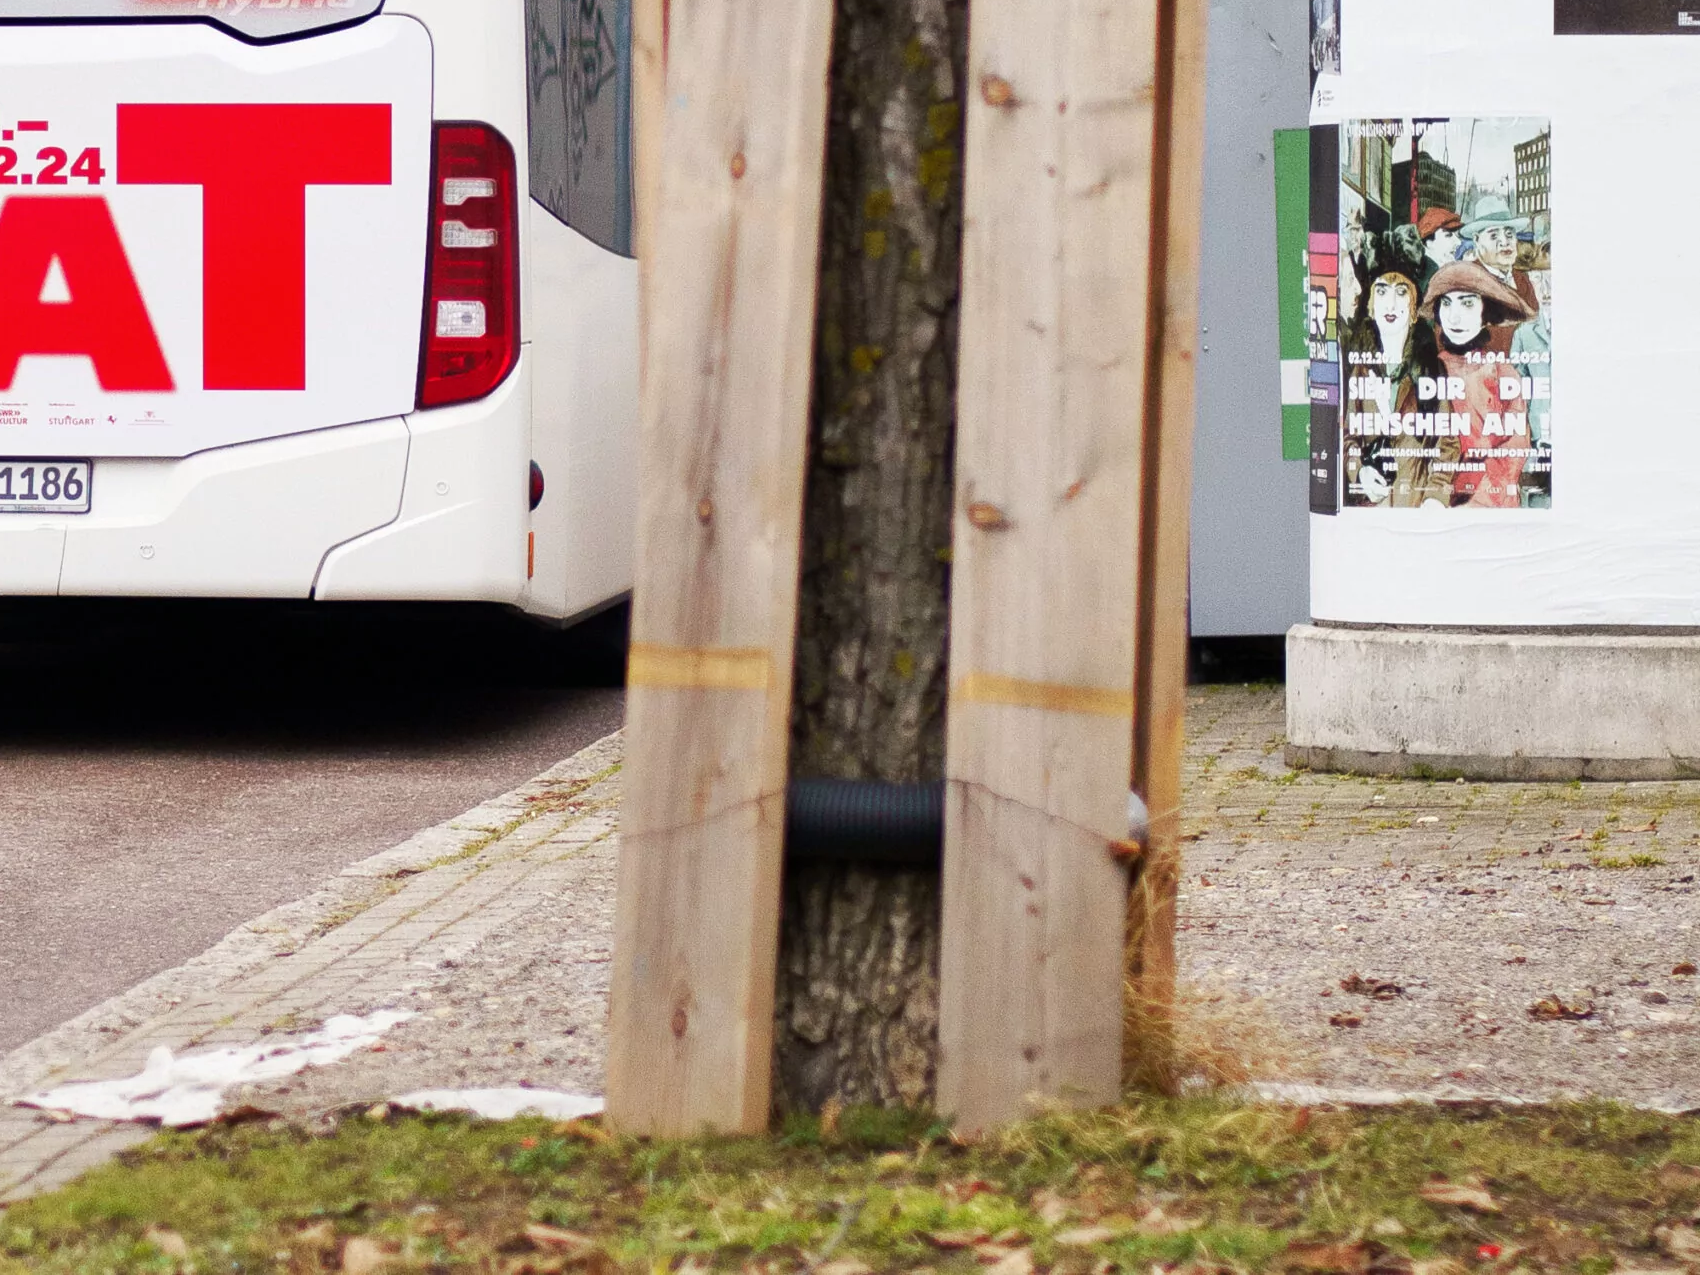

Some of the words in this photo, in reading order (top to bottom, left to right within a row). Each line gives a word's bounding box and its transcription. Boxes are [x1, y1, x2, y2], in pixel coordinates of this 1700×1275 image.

[1348, 351, 1402, 364] 02.12.20
[1464, 351, 1550, 364] 14.04.2024
[1348, 376, 1391, 400] SIEH
[1418, 376, 1466, 400] DIR
[1500, 376, 1551, 400] DIE
[48, 415, 95, 425] STUTTGART
[1348, 412, 1471, 436] MENSCHEN
[1482, 412, 1527, 436] AN
[1467, 446, 1551, 457] TYPENPORTRÄT
[1433, 462, 1486, 472] WEIMARER
